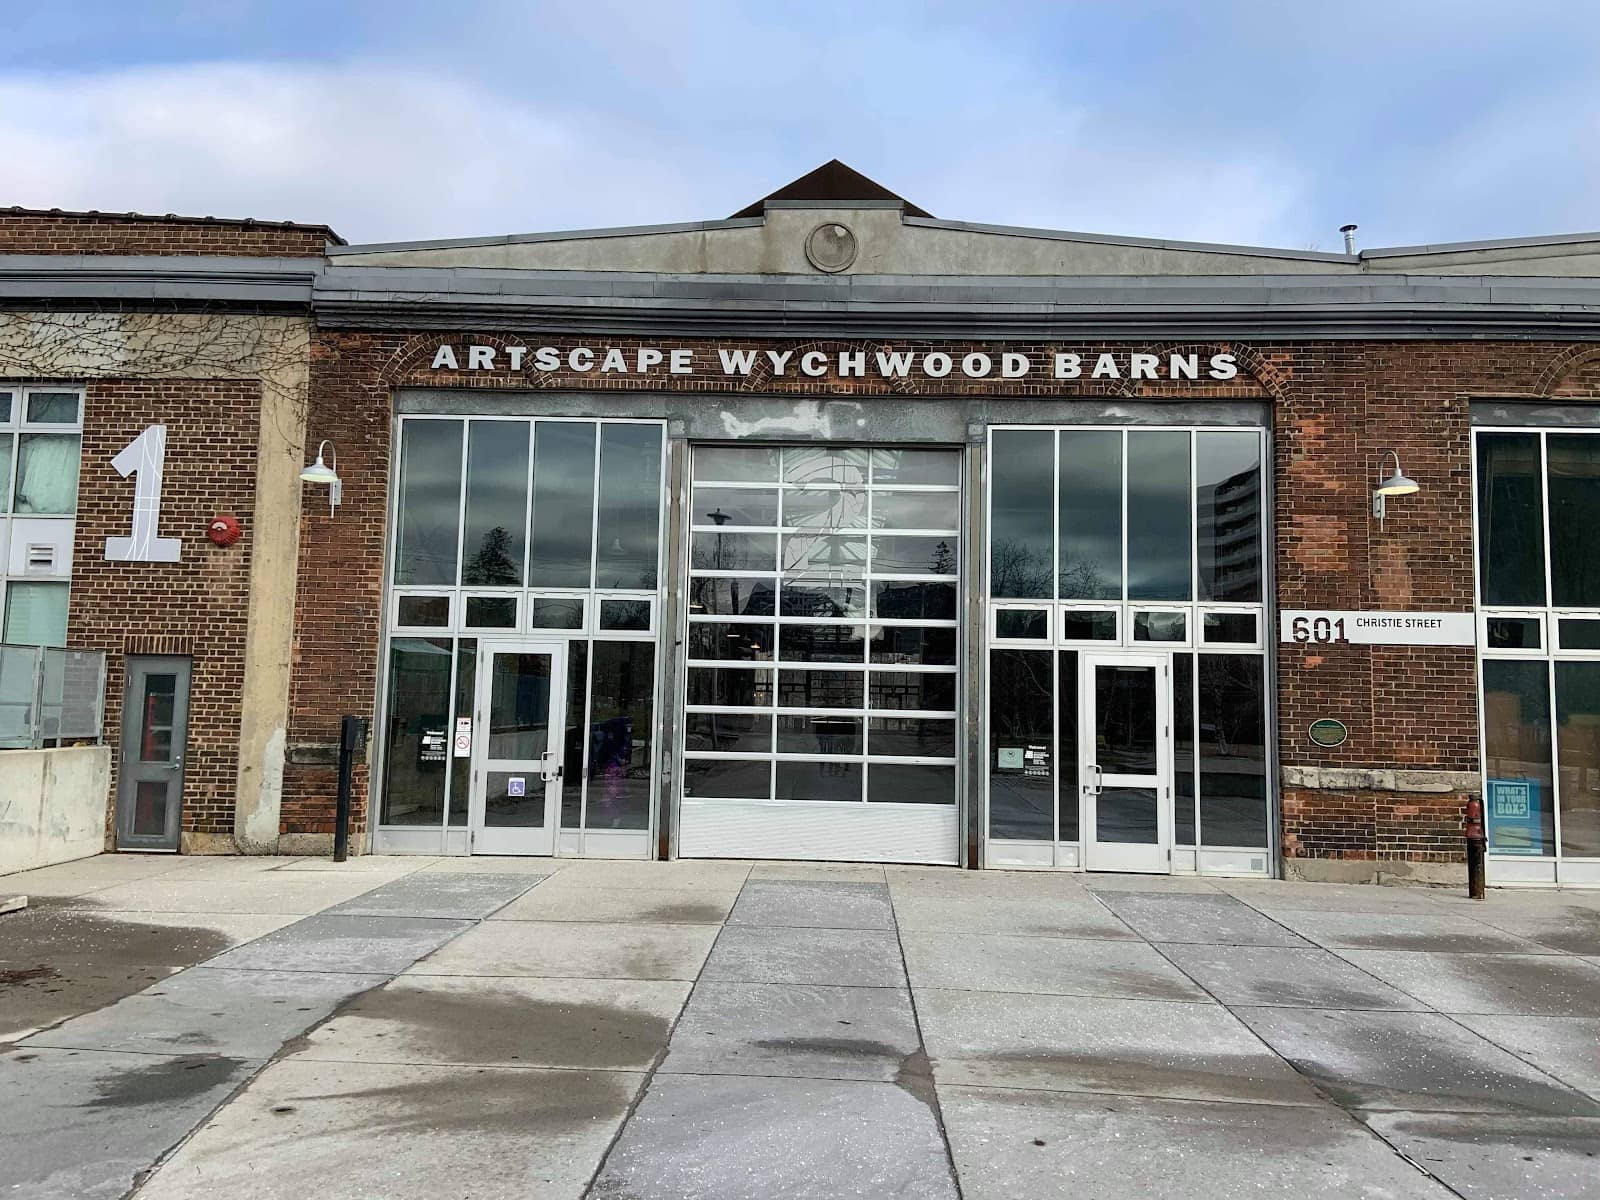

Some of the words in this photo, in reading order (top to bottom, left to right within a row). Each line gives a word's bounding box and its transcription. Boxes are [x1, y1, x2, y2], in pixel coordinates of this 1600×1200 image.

[431, 345, 694, 374] ARTSCAPE
[718, 349, 1030, 379] WYCHWOOD
[1055, 353, 1238, 380] BARNS
[104, 424, 182, 562] 1
[1292, 617, 1350, 643] 601
[1356, 617, 1403, 628] CHRISTIE
[1405, 618, 1442, 628] STREET
[1496, 786, 1527, 795] WHAT'S
[1497, 803, 1527, 815] BOX?
